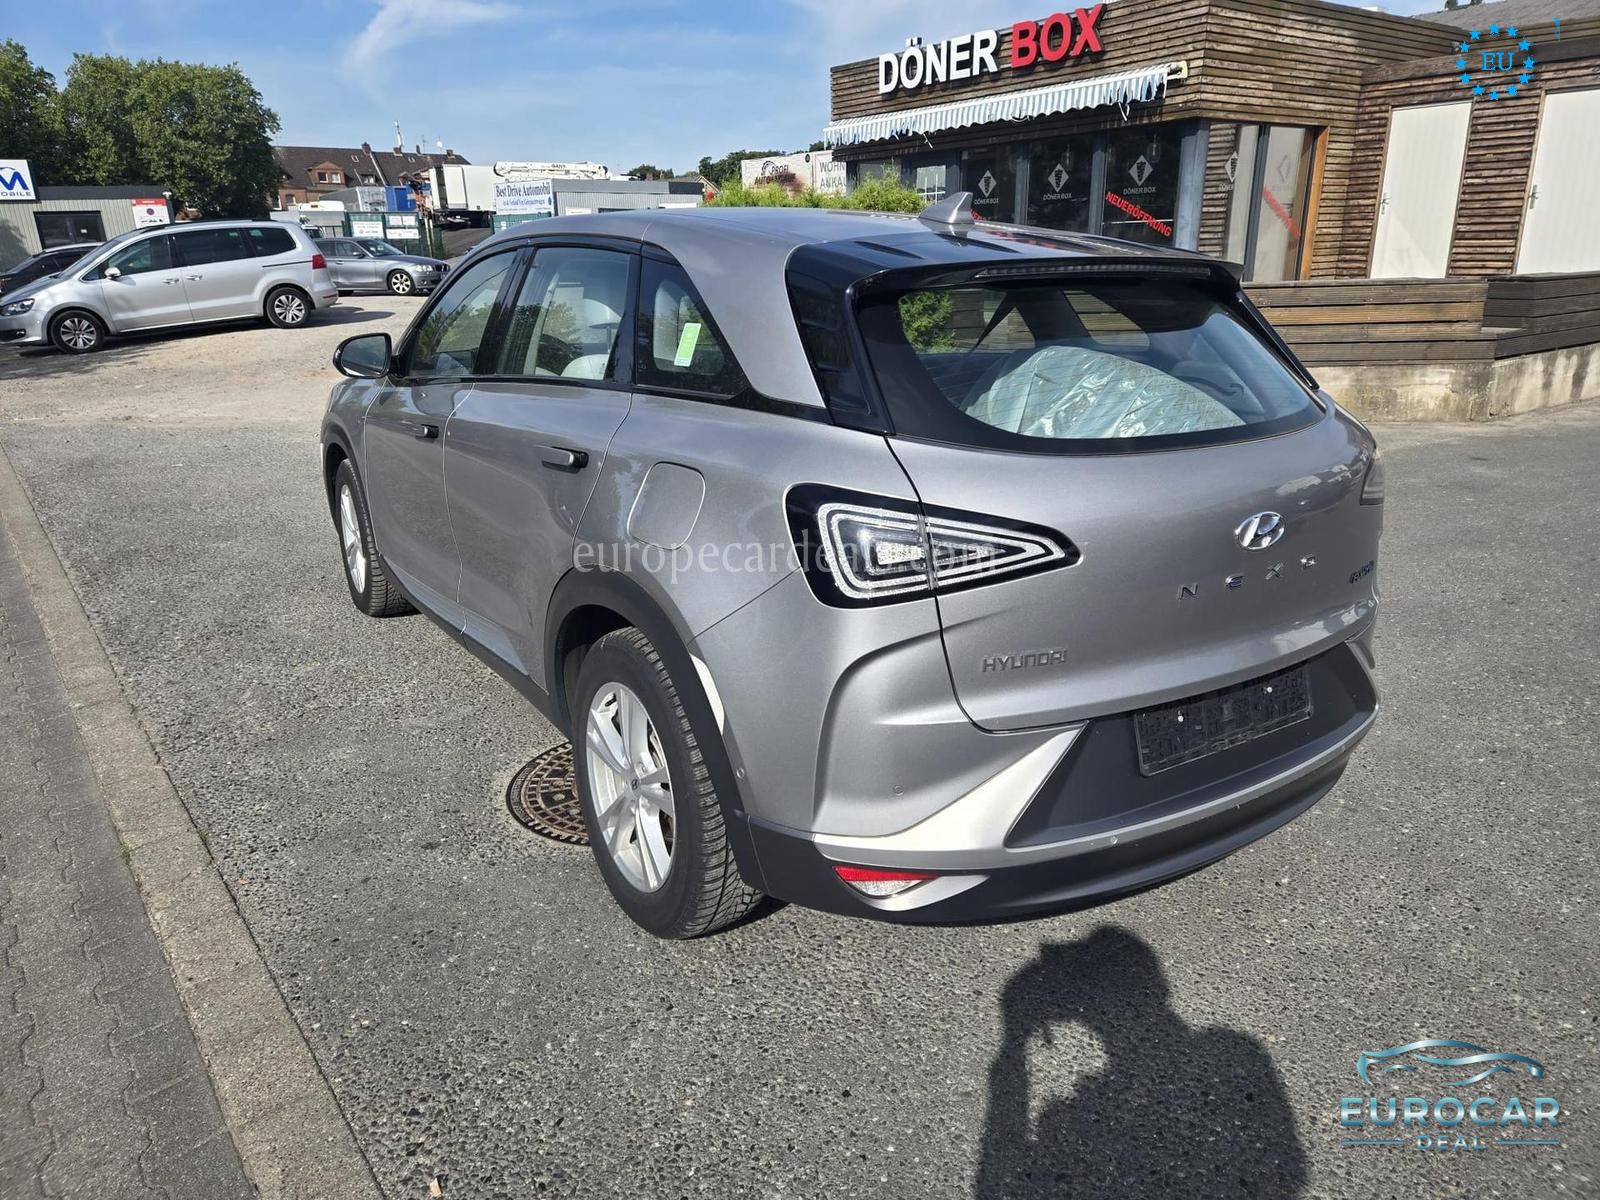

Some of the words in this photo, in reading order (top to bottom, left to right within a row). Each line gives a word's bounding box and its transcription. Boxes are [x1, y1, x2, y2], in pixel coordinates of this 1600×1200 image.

[879, 30, 998, 94] DÖNER
[1011, 4, 1104, 68] BOX
[496, 184, 507, 198] Best
[507, 184, 522, 198] Drive
[1123, 187, 1144, 196] DÖNER
[1144, 186, 1156, 194] BOX
[982, 648, 1067, 673] HYUNDAI
